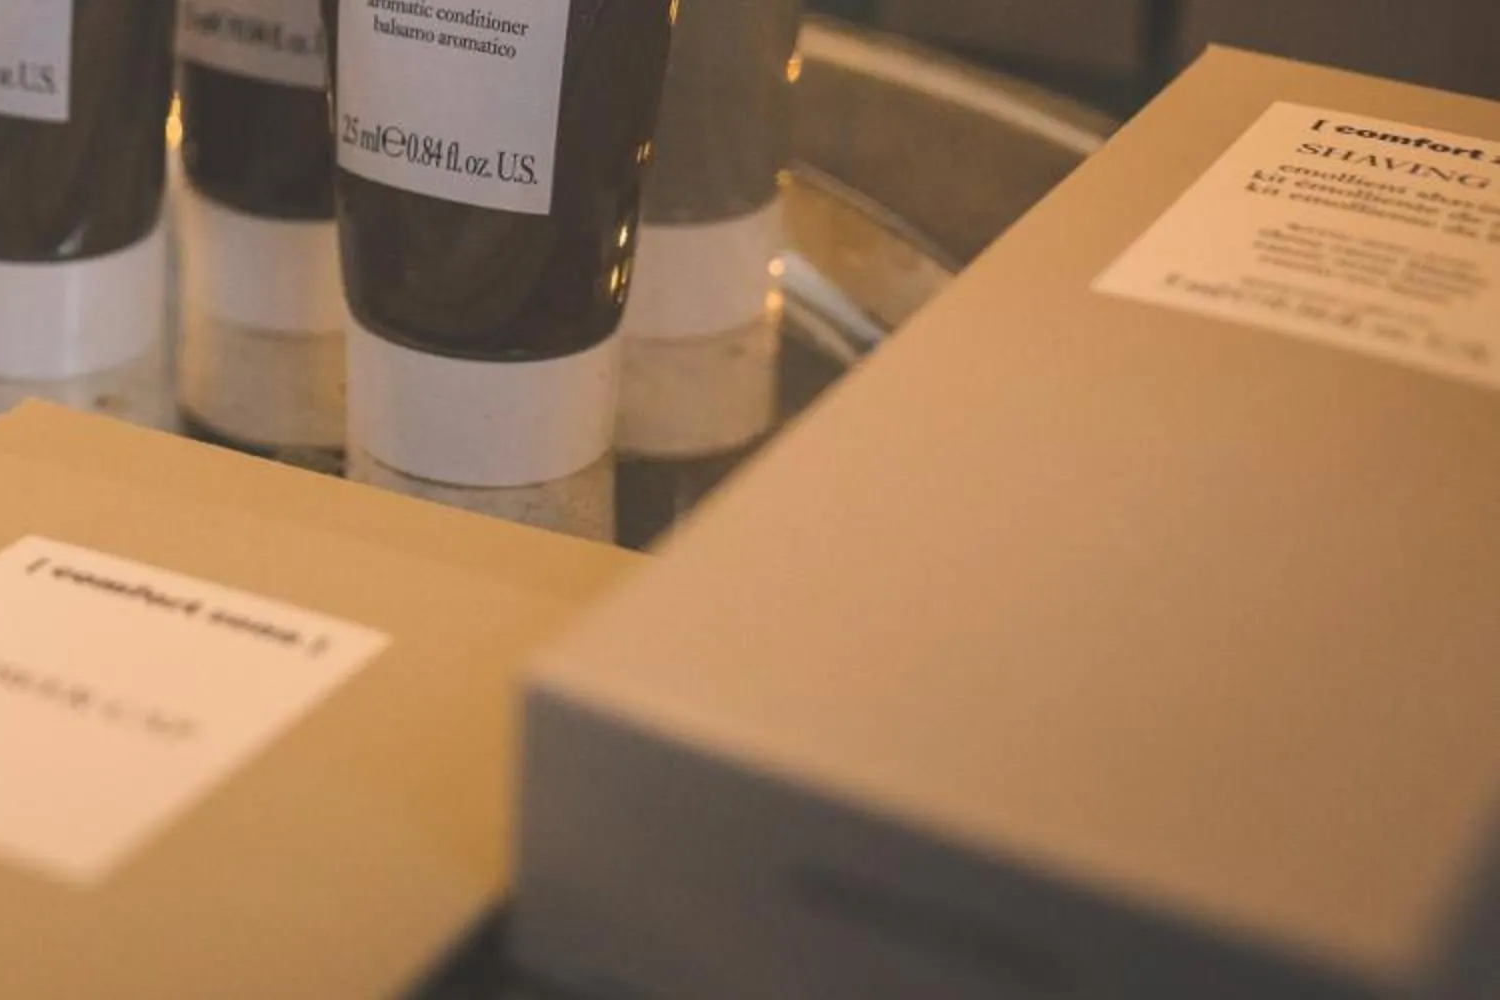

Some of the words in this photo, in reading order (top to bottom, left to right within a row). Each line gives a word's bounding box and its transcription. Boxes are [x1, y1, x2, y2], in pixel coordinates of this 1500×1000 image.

[373, 14, 435, 43] balsamo
[438, 32, 517, 59] aromatico
[436, 8, 529, 36] conditioner
[1335, 124, 1485, 161] comfort
[498, 151, 538, 185] U.S.
[1278, 164, 1407, 194] emollient
[1296, 142, 1492, 189] SHAVING
